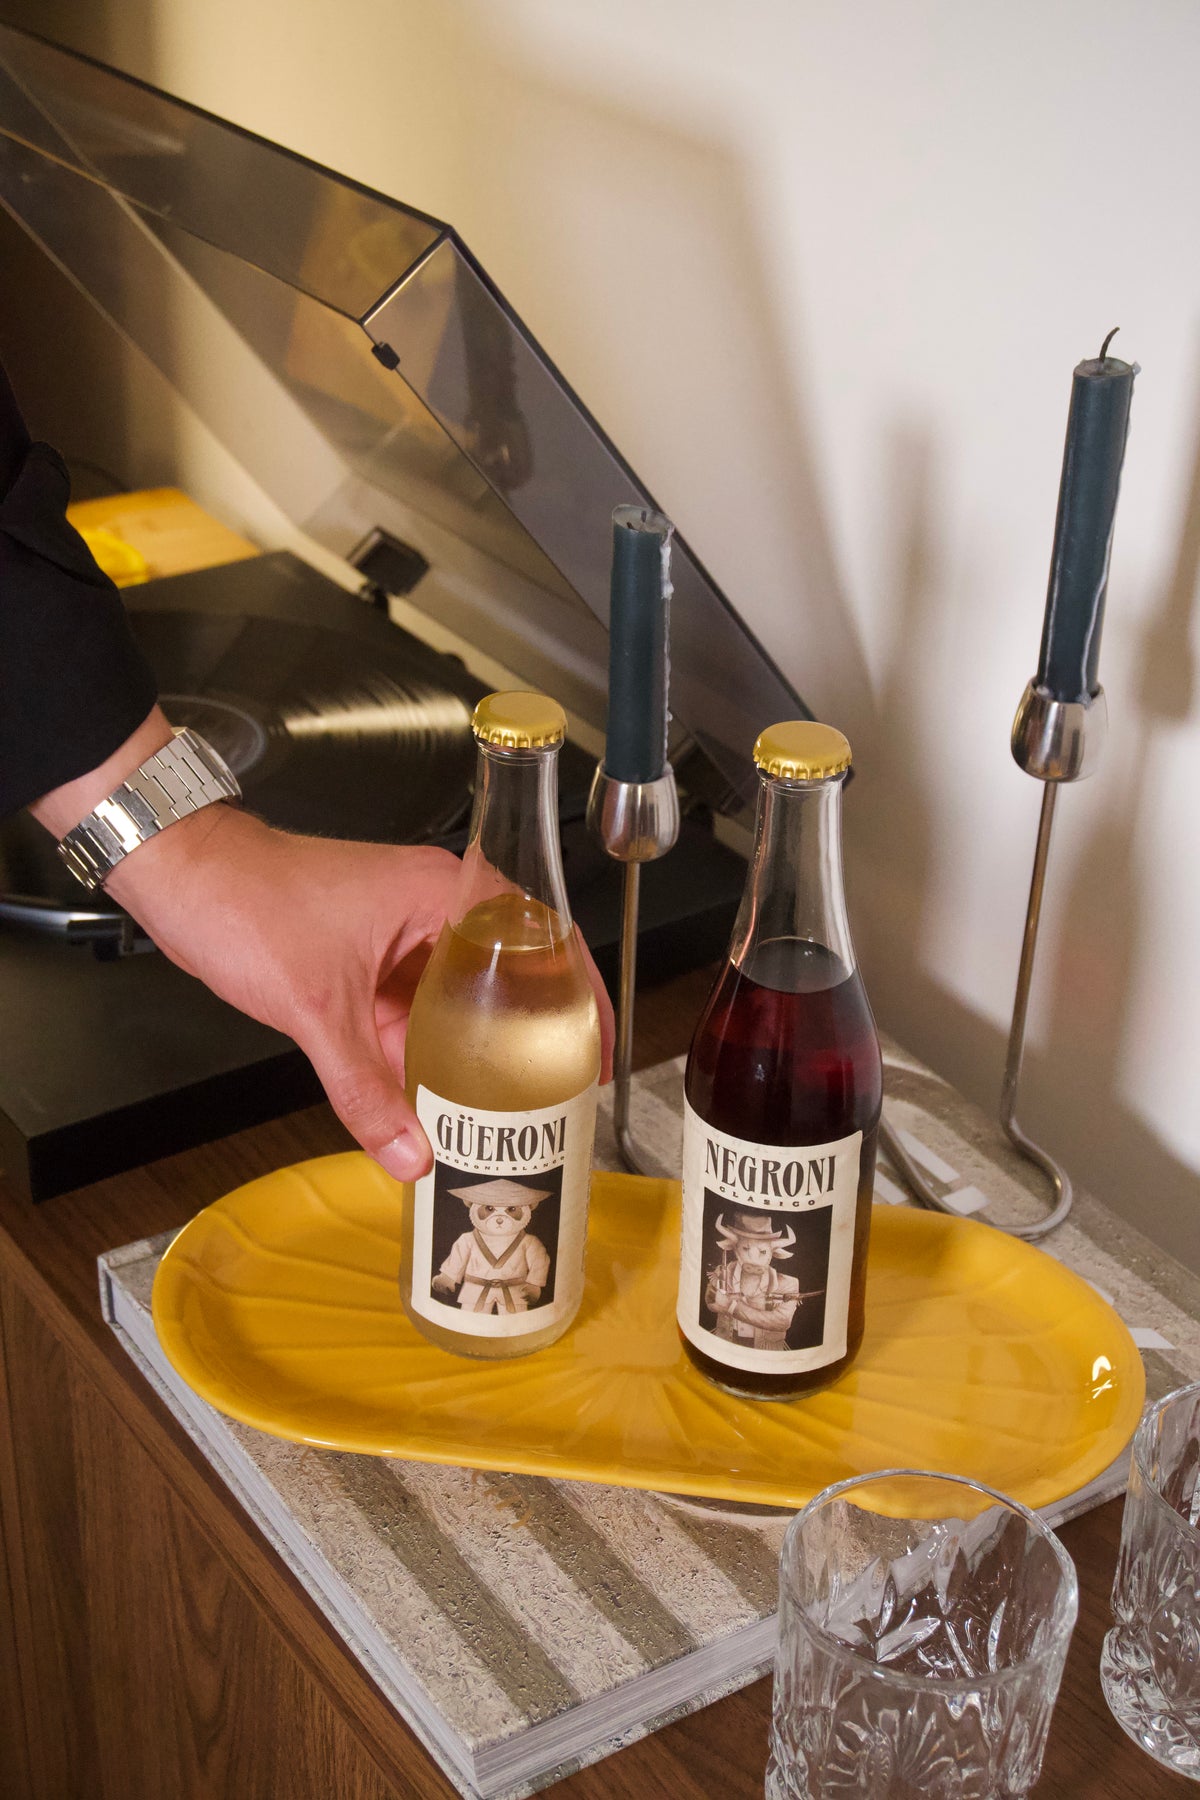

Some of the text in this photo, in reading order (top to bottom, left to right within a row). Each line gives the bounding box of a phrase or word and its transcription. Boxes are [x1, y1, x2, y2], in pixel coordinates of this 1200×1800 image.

[436, 1113, 567, 1162] GÜERONI
[436, 1151, 565, 1171] NEGRONI BLANCO
[705, 1138, 837, 1197] NEGRONI
[719, 1186, 816, 1207] CLASICO
